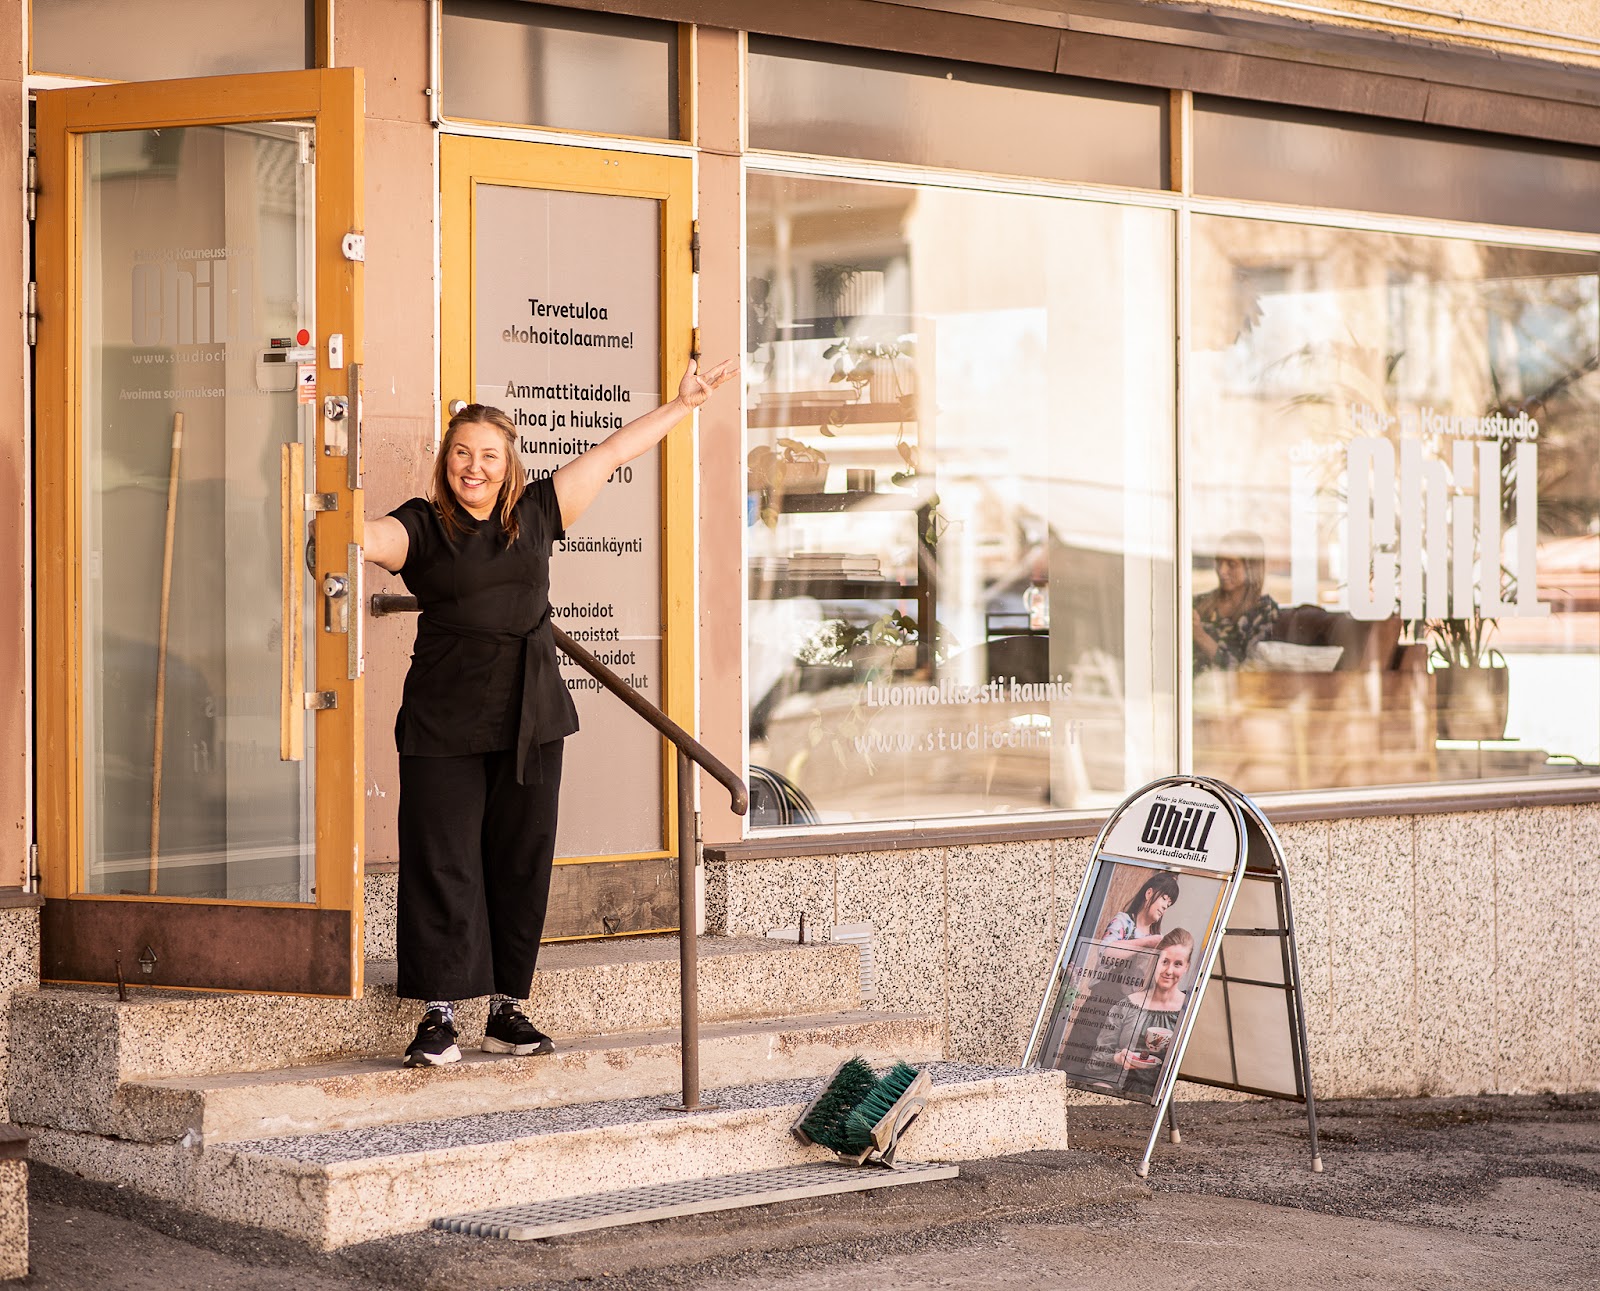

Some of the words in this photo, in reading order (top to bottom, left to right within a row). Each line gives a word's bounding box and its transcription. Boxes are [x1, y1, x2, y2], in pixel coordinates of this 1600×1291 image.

[528, 298, 608, 320] Tervetuloa
[502, 325, 634, 349] ekohoitolaamme!
[118, 387, 161, 401] Avoinna
[163, 386, 226, 401] sopimuksen
[505, 380, 630, 402] Ammattitaidolla
[514, 409, 547, 426] ihoa
[550, 409, 566, 431] ja
[570, 410, 623, 429] hiuksia
[1420, 406, 1539, 440] Kauneusstudio
[521, 435, 601, 455] kunnioitt
[559, 537, 642, 557] Sisäänkäynti
[550, 602, 614, 618] svohoidot
[565, 626, 620, 642] npoistot
[867, 676, 1005, 707] Luonnollisesti
[1010, 674, 1073, 702] kaunis
[1137, 845, 1208, 863] www.studiochill.fi
[1100, 955, 1132, 968] RESEPTI
[1077, 968, 1145, 987] RENTOUTUMISEEN
